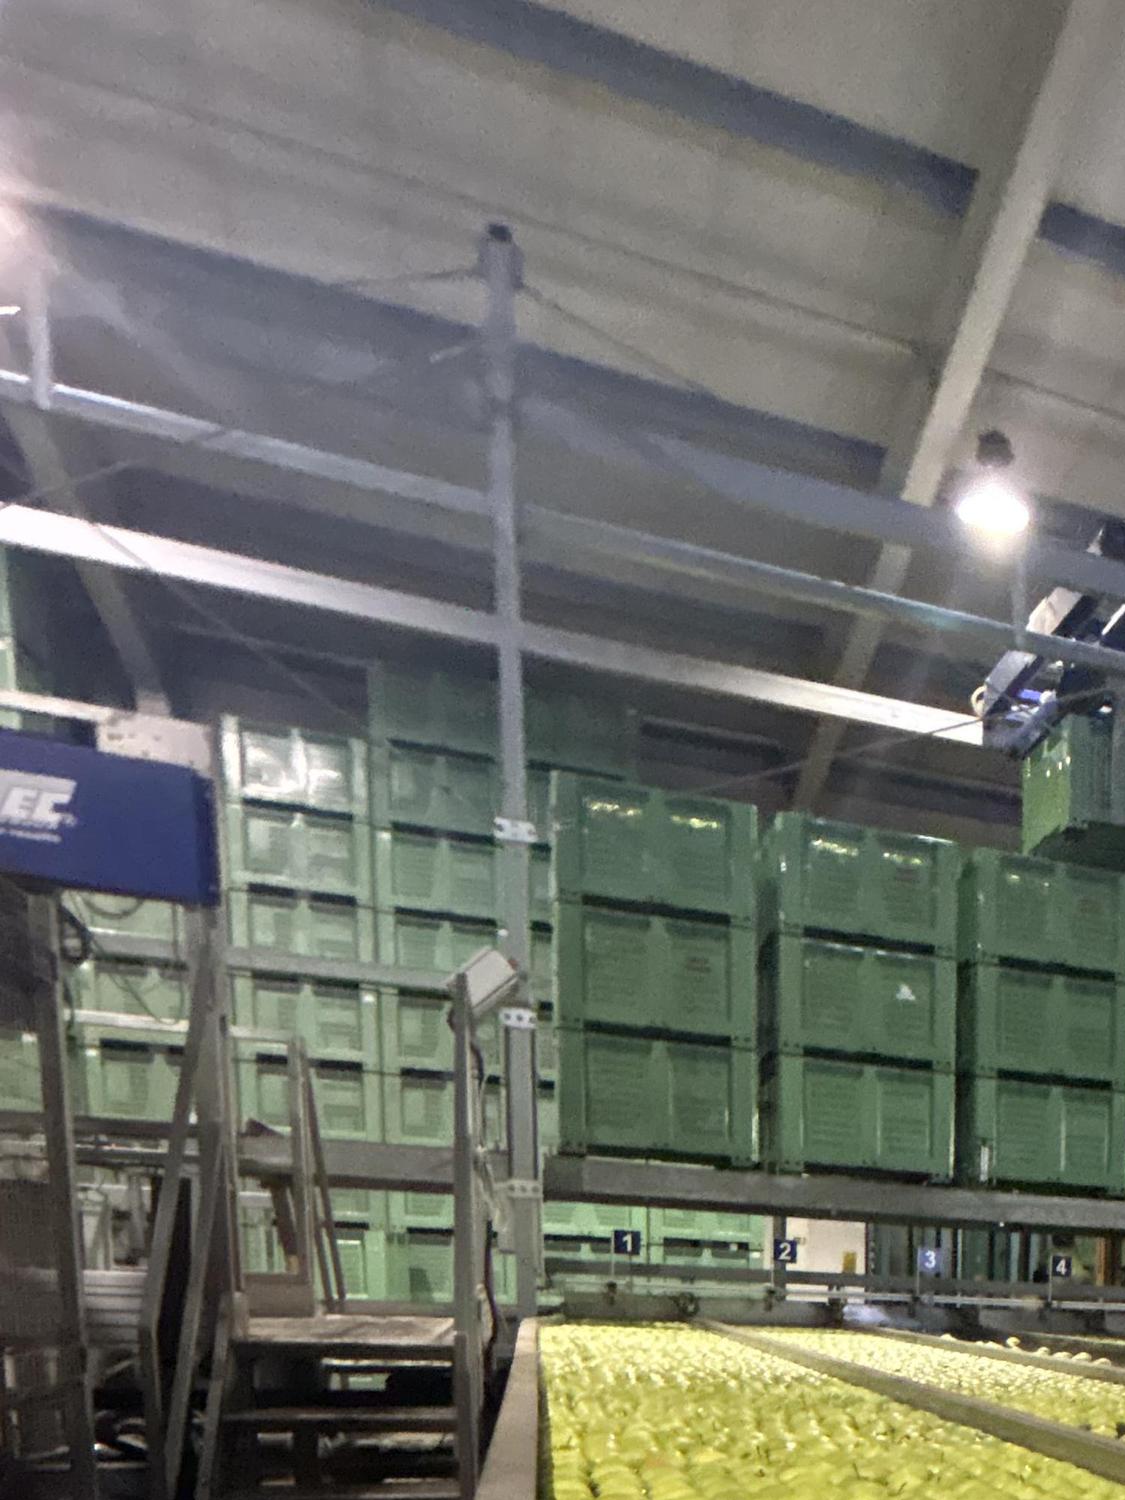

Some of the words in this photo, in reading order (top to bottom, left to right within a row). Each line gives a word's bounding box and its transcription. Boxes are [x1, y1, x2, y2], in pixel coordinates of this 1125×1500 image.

[622, 1233, 633, 1252] 1
[779, 1242, 791, 1261] 2
[925, 1250, 937, 1269] 3
[1055, 1257, 1067, 1275] 4
